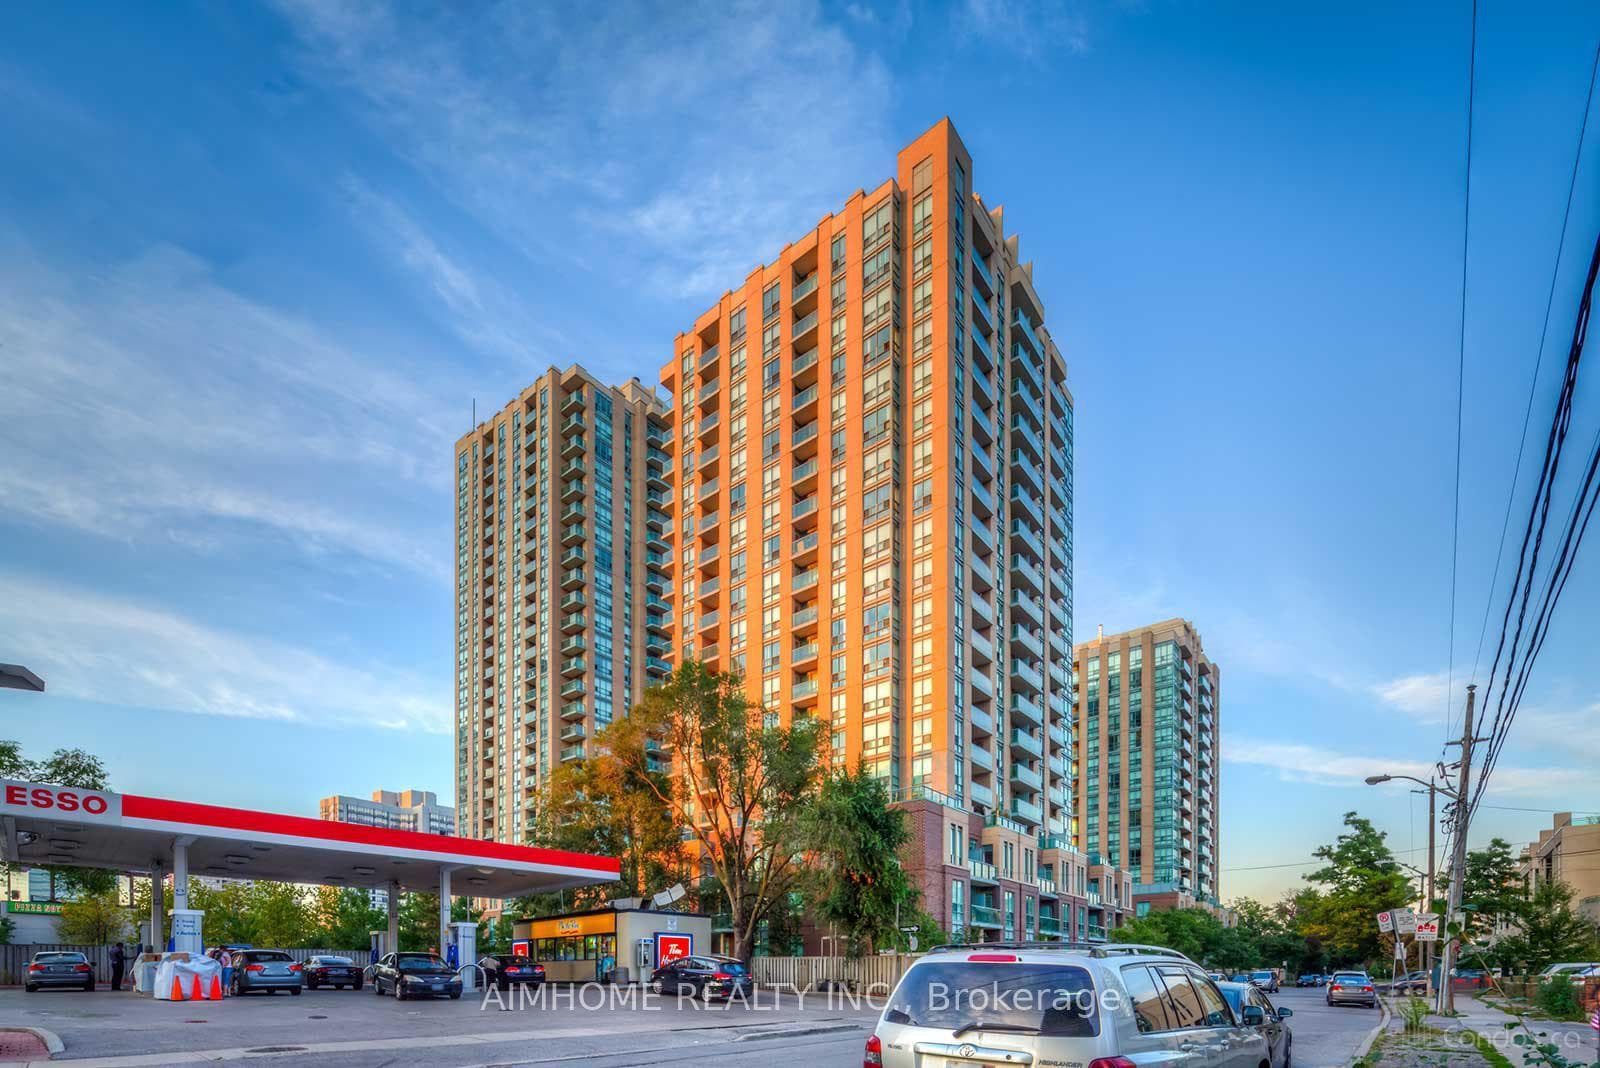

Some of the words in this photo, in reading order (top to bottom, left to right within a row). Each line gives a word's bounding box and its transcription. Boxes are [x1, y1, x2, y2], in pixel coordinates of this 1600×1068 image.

[6, 785, 108, 815] ESSO
[668, 943, 683, 955] Tim
[1038, 1059, 1083, 1068] HIGHLANDER
